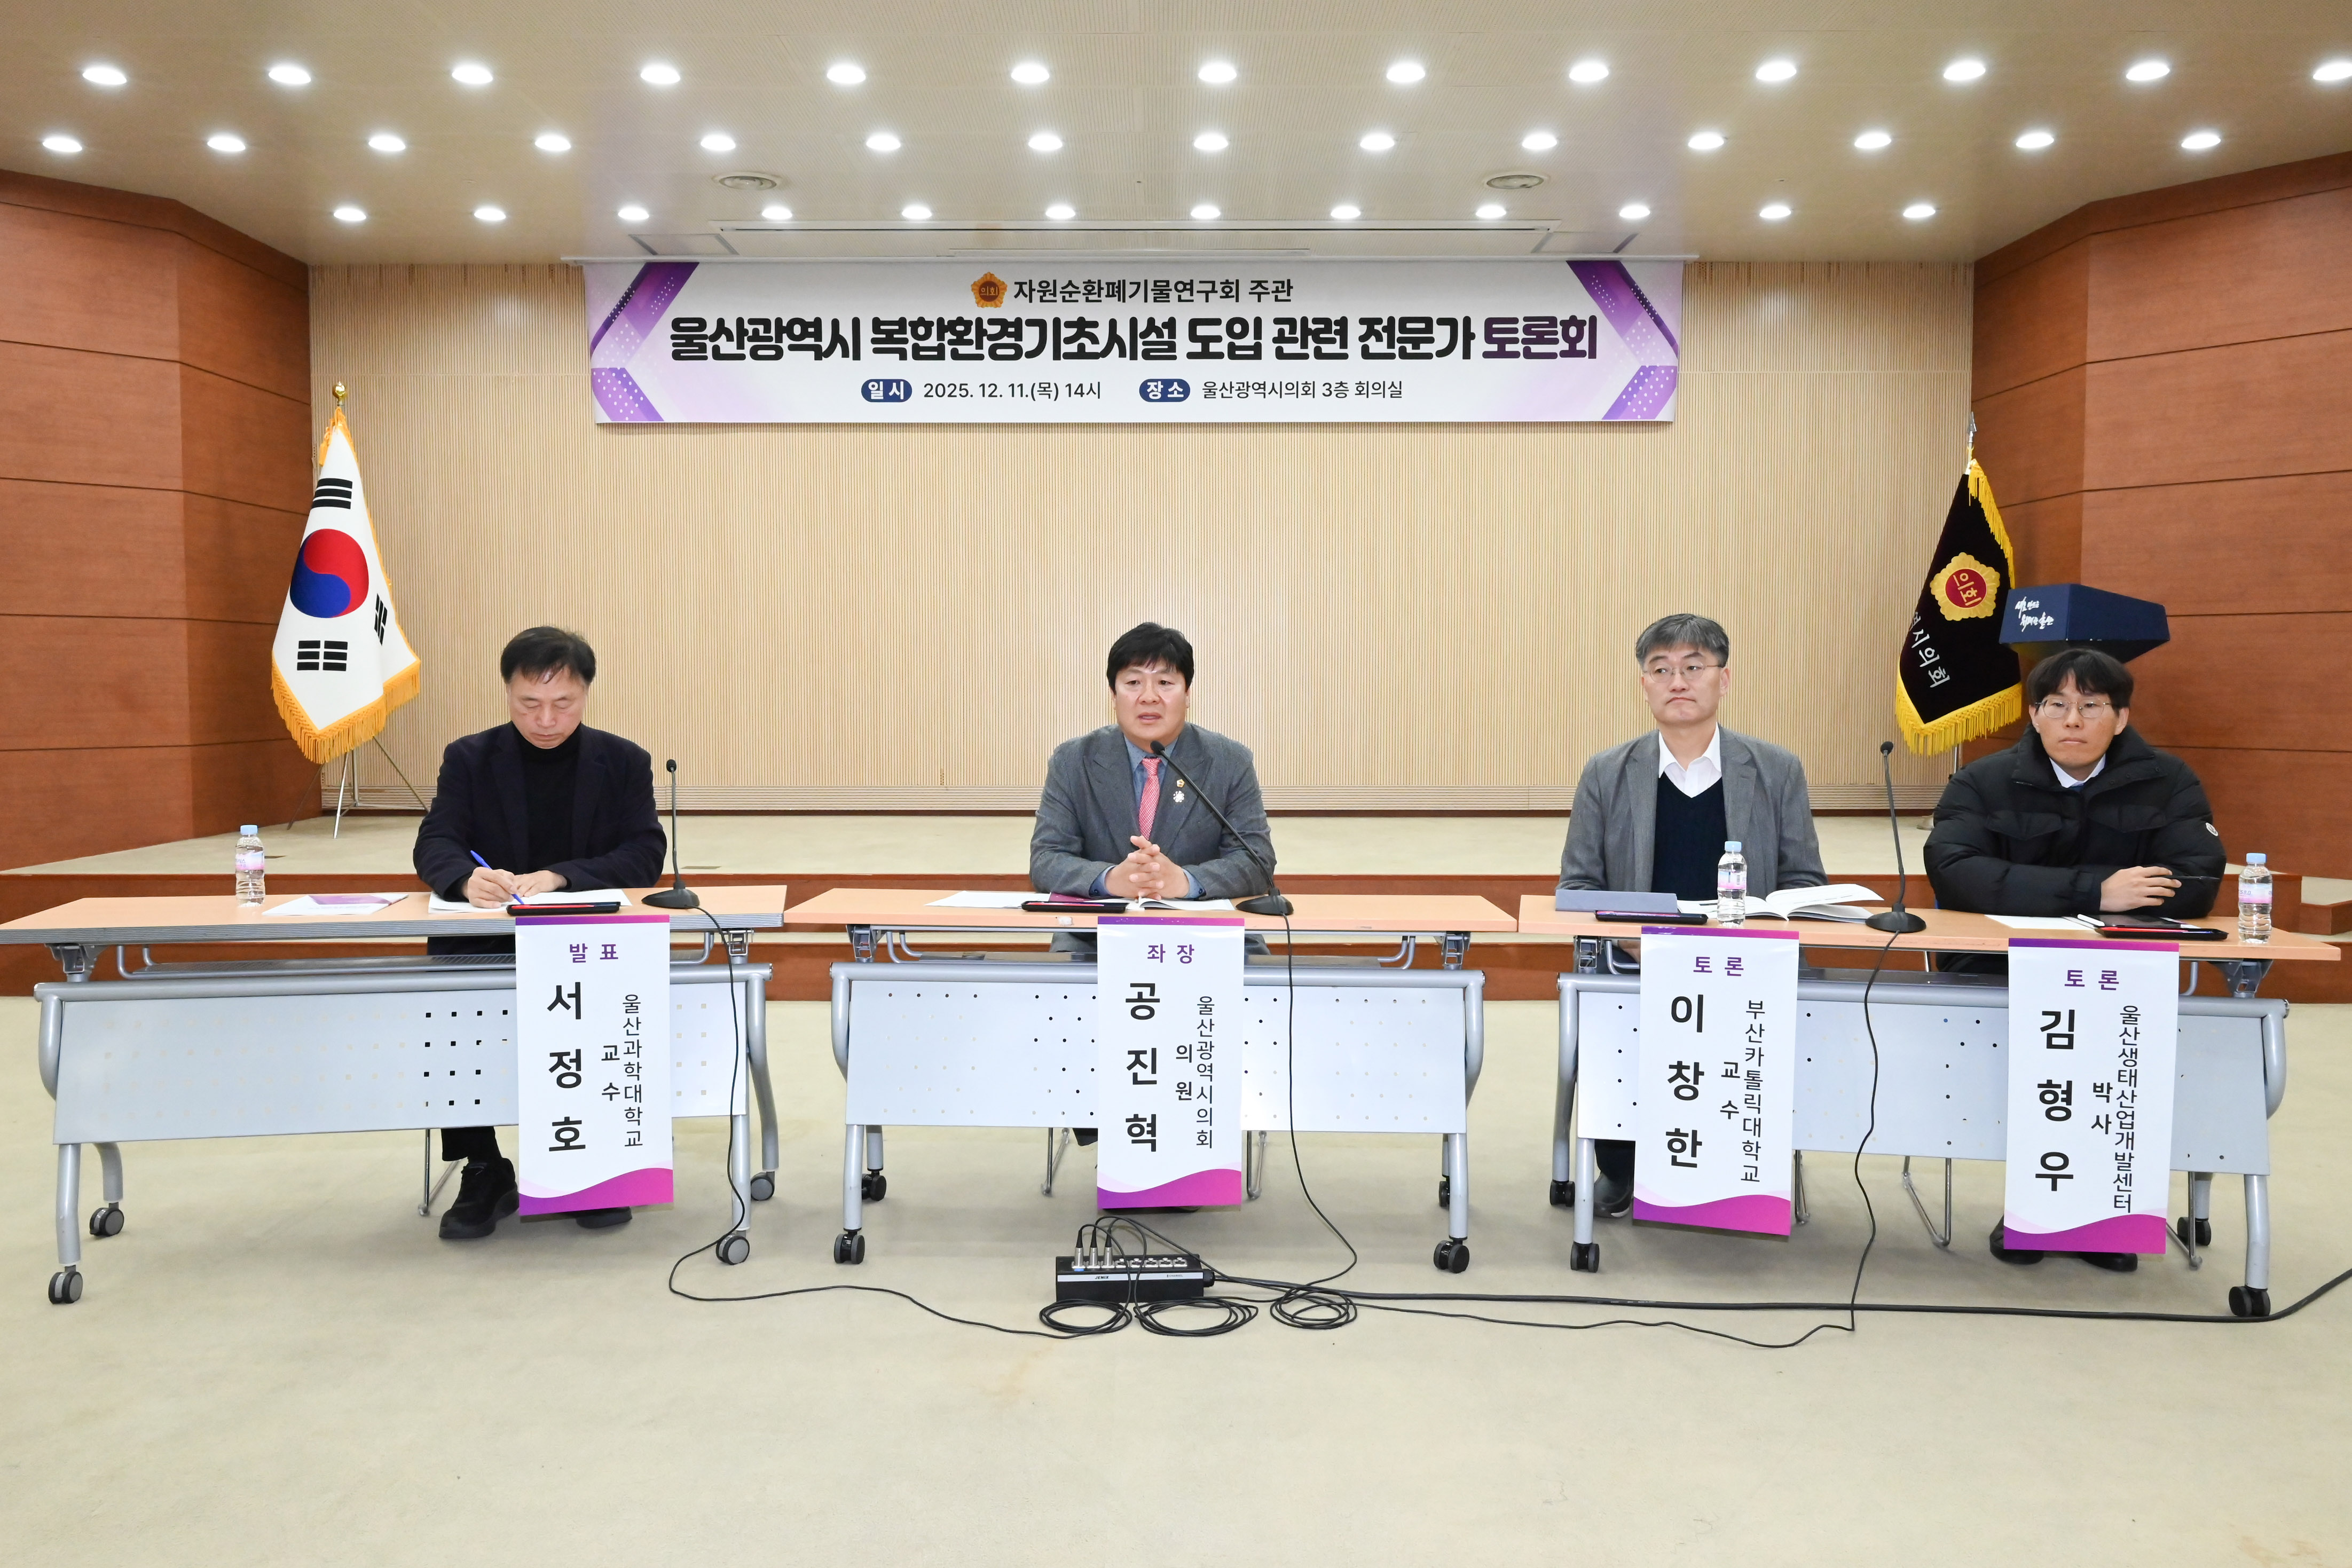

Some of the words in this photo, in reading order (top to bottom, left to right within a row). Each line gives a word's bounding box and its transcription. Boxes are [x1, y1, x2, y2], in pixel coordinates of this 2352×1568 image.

[980, 286, 998, 296] 의회
[1013, 279, 1239, 303] 자원순환폐기물연구회
[1248, 278, 1294, 303] 주관
[670, 316, 861, 361] 울산광역시
[870, 316, 1177, 361] 복합환경기초시설
[1186, 316, 1262, 360] 도입
[1272, 316, 1349, 360] 관련
[1358, 316, 1476, 360] 전문가
[1482, 314, 1598, 360] 토론회
[924, 383, 973, 398] 2025.
[979, 383, 1003, 398] 12.
[1008, 382, 1059, 401] 11.(목)
[1065, 381, 1100, 399] 14시
[1202, 381, 1315, 399] 울산광역시의회
[1322, 381, 1349, 399] 3층
[1355, 381, 1402, 399] 회의실
[1953, 572, 1982, 606] 의회
[547, 981, 586, 1152] 서정호
[601, 1045, 620, 1101] 교수
[622, 994, 643, 1147] 울산과학대학교
[1125, 983, 1160, 1152] 공진혁
[1175, 1044, 1192, 1101] 의원
[1196, 996, 1215, 1149] 울산광역시의회
[1665, 994, 1705, 1168] 이창한
[1720, 1061, 1741, 1120] 교수
[1741, 1000, 1765, 1183] 부산카톨릭대학교
[2035, 1009, 2075, 1192] 김형우
[2091, 1082, 2113, 1135] 박사
[2113, 1005, 2141, 1214] 울산생태산업개발센터
